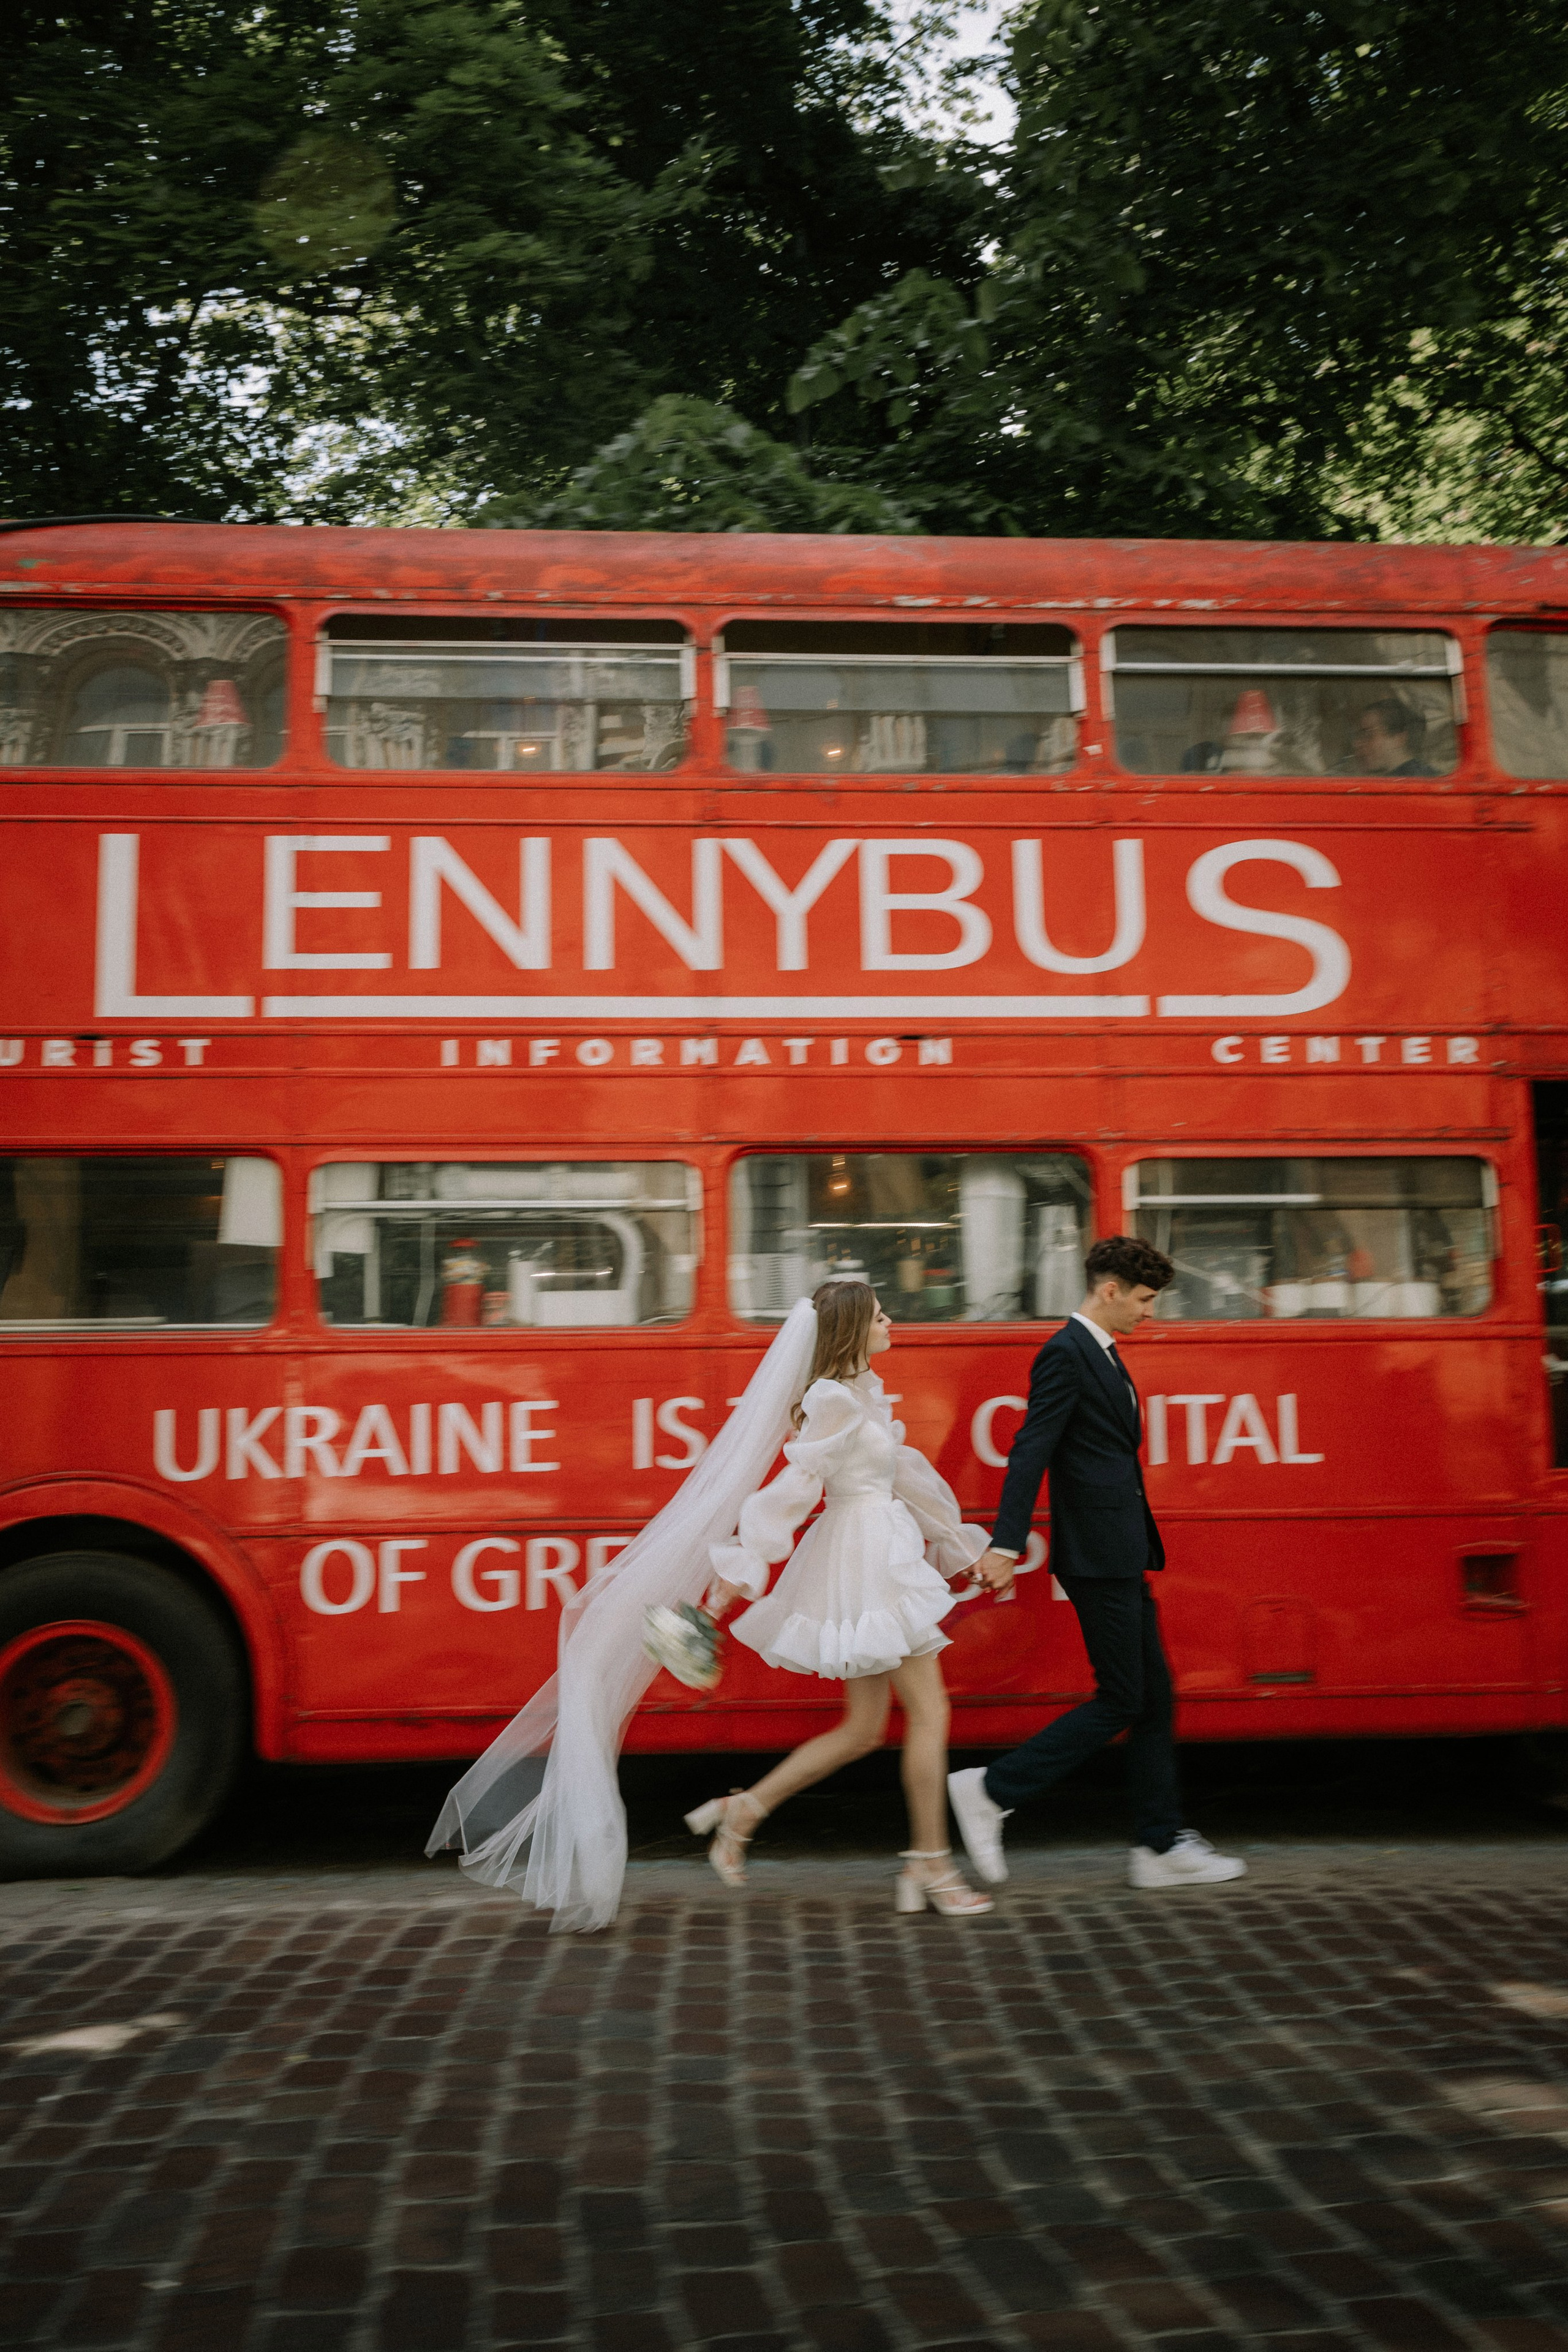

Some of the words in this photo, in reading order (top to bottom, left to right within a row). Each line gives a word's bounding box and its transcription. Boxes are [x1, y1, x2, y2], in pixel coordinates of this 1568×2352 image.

[94, 833, 1352, 1018] LENNYBUS
[440, 1037, 953, 1066] INFORMATION
[1210, 1036, 1480, 1065] CENTER
[153, 1400, 561, 1482] UKRAINE
[632, 1396, 709, 1469] IS
[970, 1393, 1325, 1468] CITAL
[299, 1539, 429, 1615] OF
